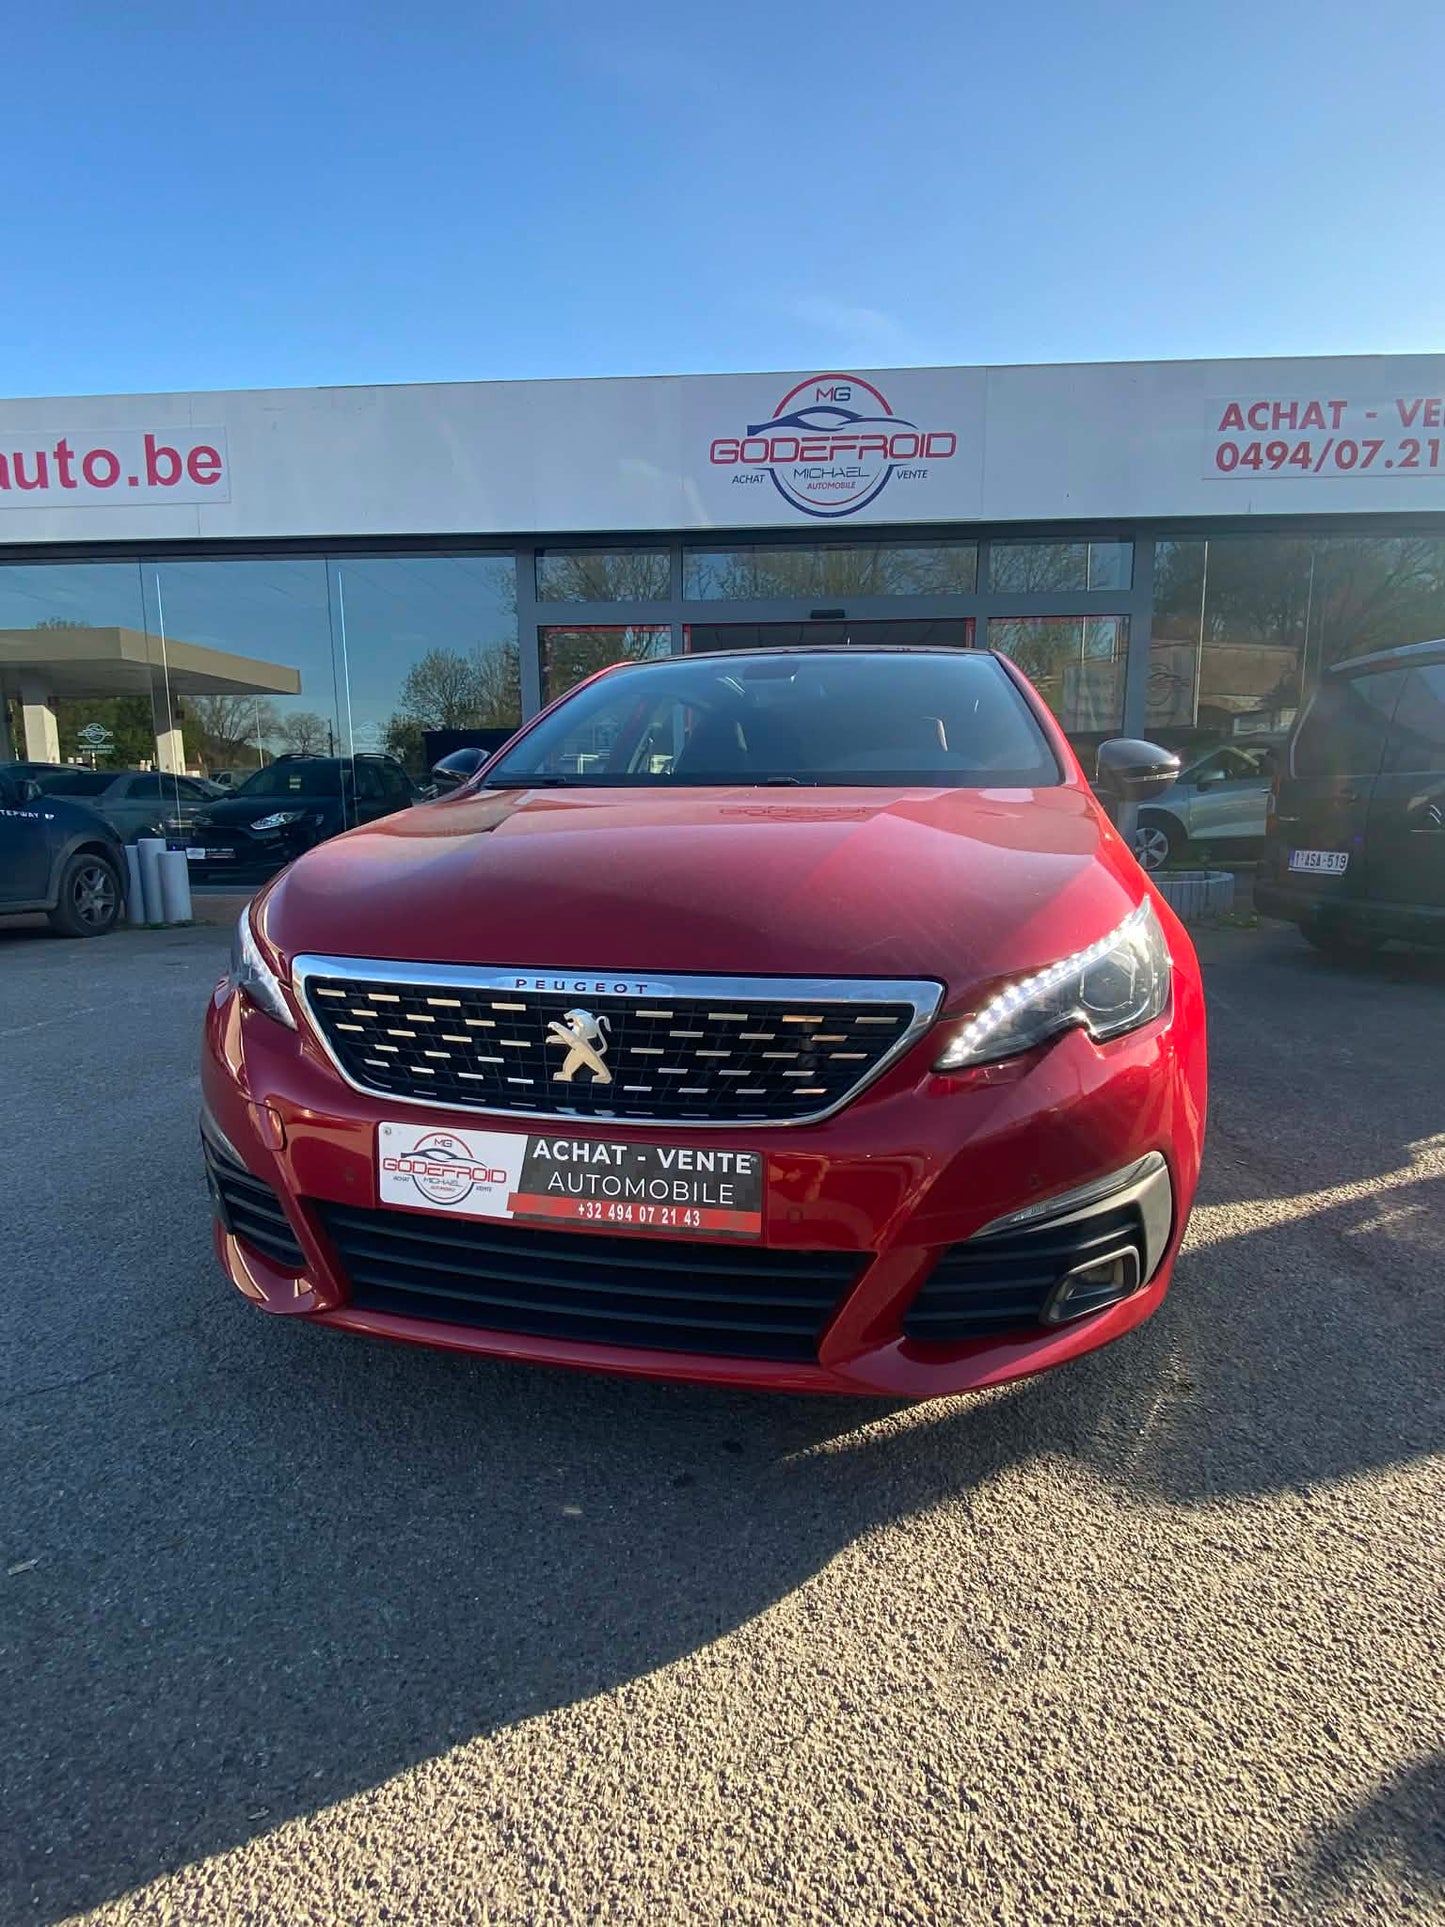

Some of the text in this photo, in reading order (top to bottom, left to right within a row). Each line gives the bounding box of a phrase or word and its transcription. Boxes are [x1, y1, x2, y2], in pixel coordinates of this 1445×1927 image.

[816, 387, 851, 402] MG
[1217, 400, 1348, 431] ACHAT
[1396, 398, 1445, 427] VE
[710, 432, 957, 464] GODEFROID
[1215, 438, 1440, 472] 0494/07.21
[732, 474, 766, 484] ACHAT
[793, 466, 870, 479] MICHAEL
[896, 469, 929, 479] VENTE
[806, 481, 856, 490] AUTOMOBILE
[515, 979, 648, 994] PEUGEOT
[434, 1138, 453, 1148] MG
[532, 1139, 628, 1165] ACHAT
[656, 1148, 752, 1174] VENTE
[383, 1157, 507, 1184] GODEFROID
[548, 1171, 735, 1205] AUTOMOBILE
[578, 1201, 701, 1227] +32 494 07 21 43
